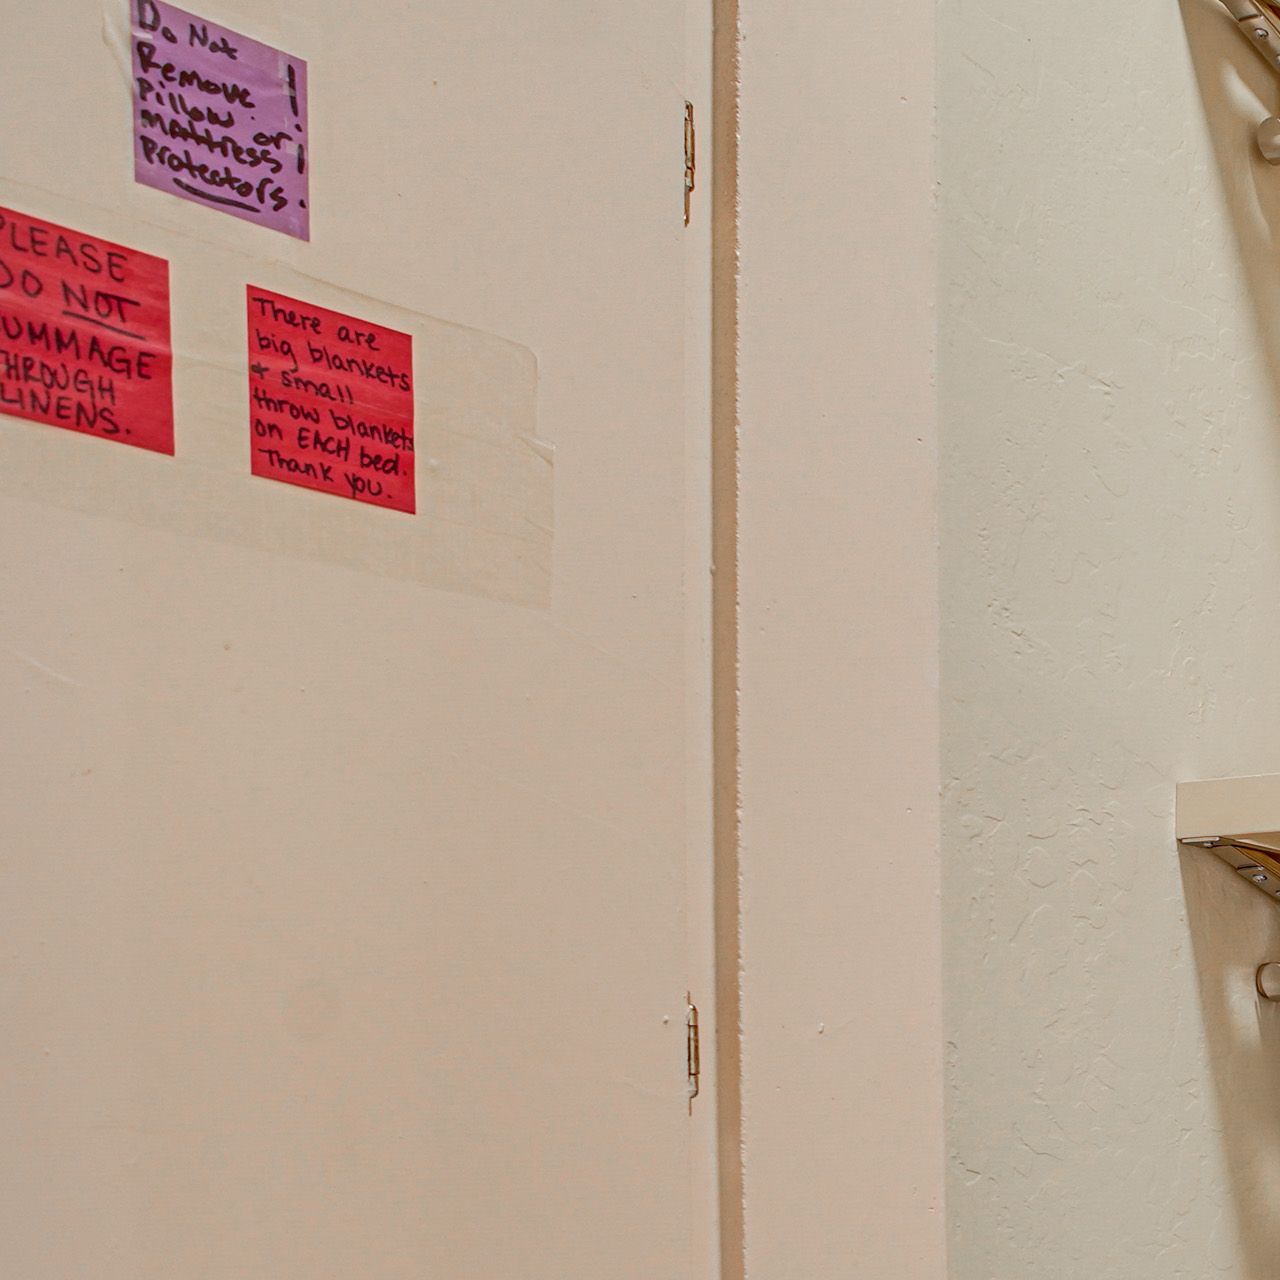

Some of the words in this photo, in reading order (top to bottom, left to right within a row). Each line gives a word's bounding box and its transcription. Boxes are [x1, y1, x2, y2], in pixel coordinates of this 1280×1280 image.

[137, 0, 178, 44] Do
[189, 23, 238, 60] Not
[137, 40, 256, 108] Remove
[136, 77, 234, 128] Pillow
[253, 132, 293, 150] or
[0, 260, 43, 298] DO
[61, 280, 142, 323] NOT
[0, 315, 156, 380] UMMAGE
[251, 297, 322, 335] There
[337, 326, 381, 351] are
[256, 329, 298, 373] big
[307, 341, 411, 392] blankets
[281, 370, 354, 405] small
[0, 381, 132, 435] LINENS.
[254, 387, 320, 424] throw
[329, 409, 415, 452] blankets
[254, 419, 283, 440] on
[297, 427, 350, 461] EACH
[360, 446, 408, 476] bed.
[258, 448, 334, 482] Thank
[344, 472, 393, 499] you.
